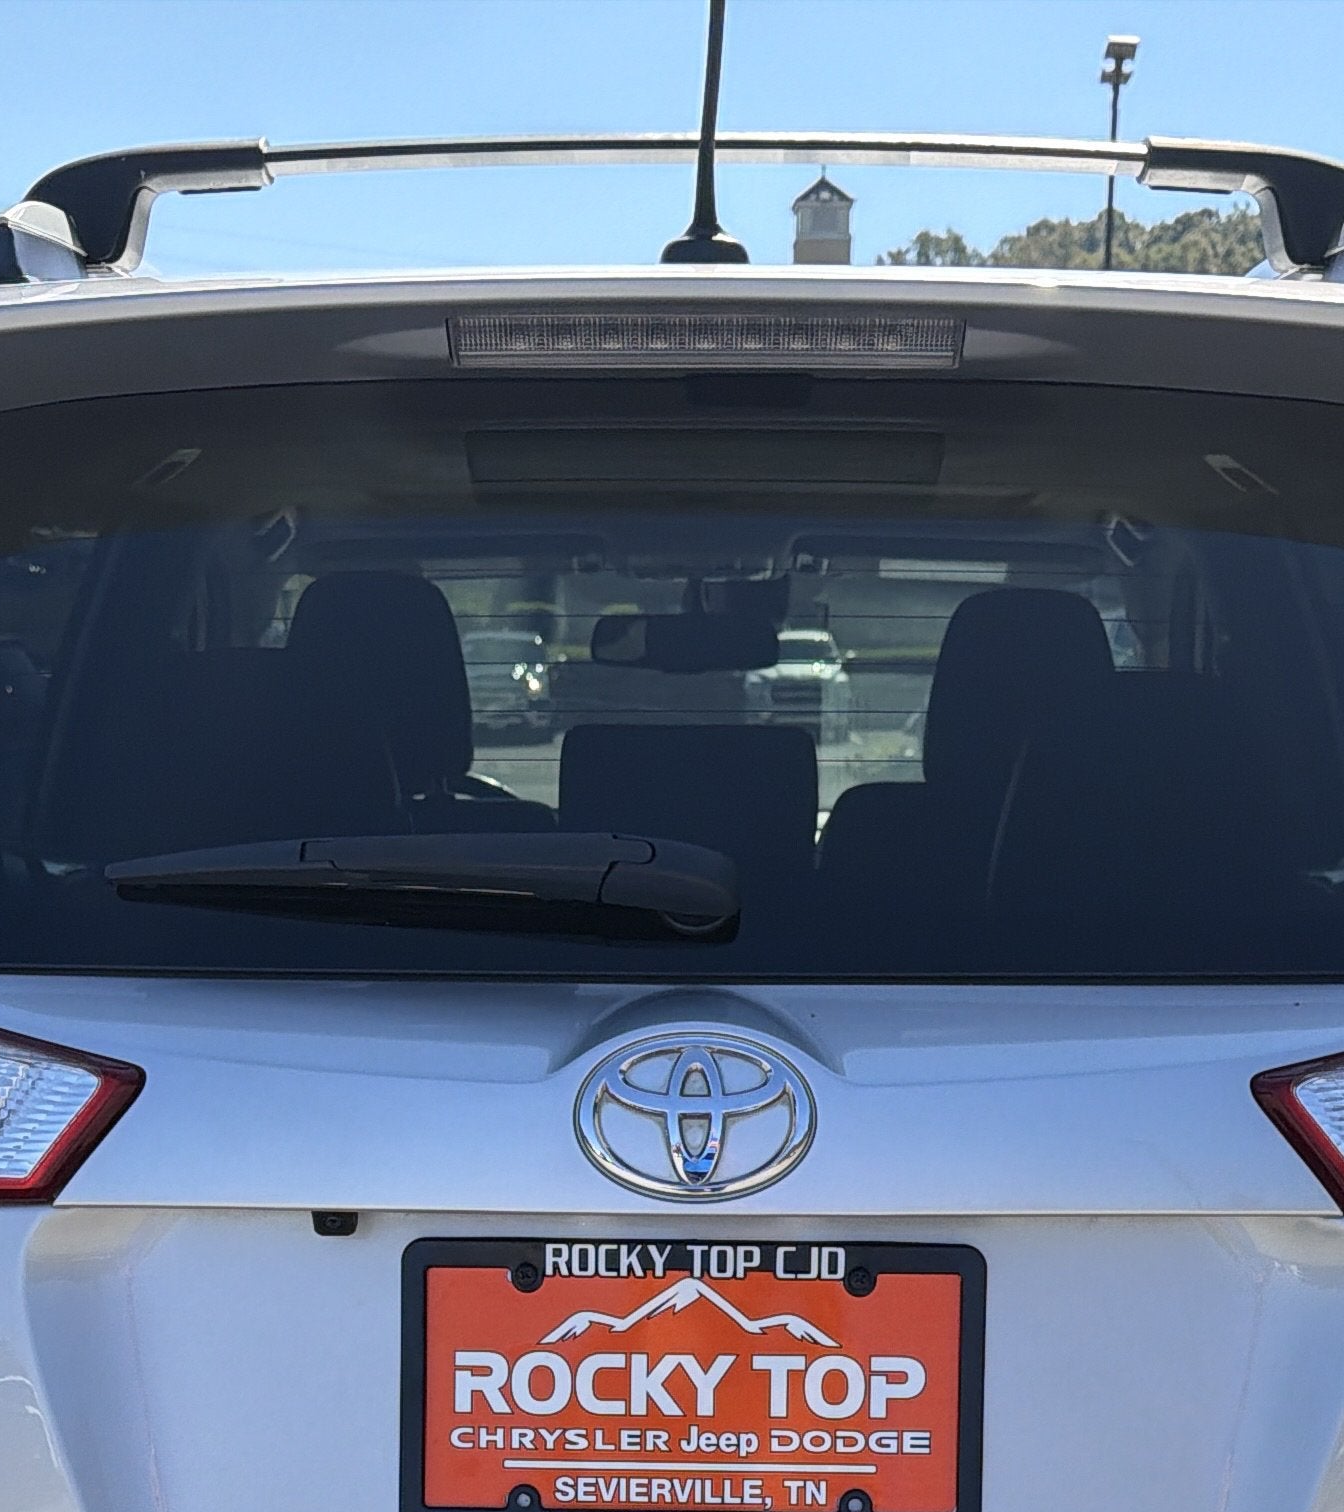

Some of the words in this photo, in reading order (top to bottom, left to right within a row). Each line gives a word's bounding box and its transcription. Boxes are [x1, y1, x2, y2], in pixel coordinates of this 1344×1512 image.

[544, 1243, 673, 1278] ROCKY
[686, 1244, 761, 1279] TOP
[775, 1245, 846, 1281] CJD
[453, 1351, 740, 1417] ROCKY
[752, 1354, 927, 1419] TOP
[449, 1426, 671, 1452] CHRYSLER
[679, 1425, 759, 1458] Jeep
[770, 1430, 932, 1455] DODGE
[554, 1477, 774, 1509] SEVIERVILLE,
[784, 1479, 828, 1506] TN
